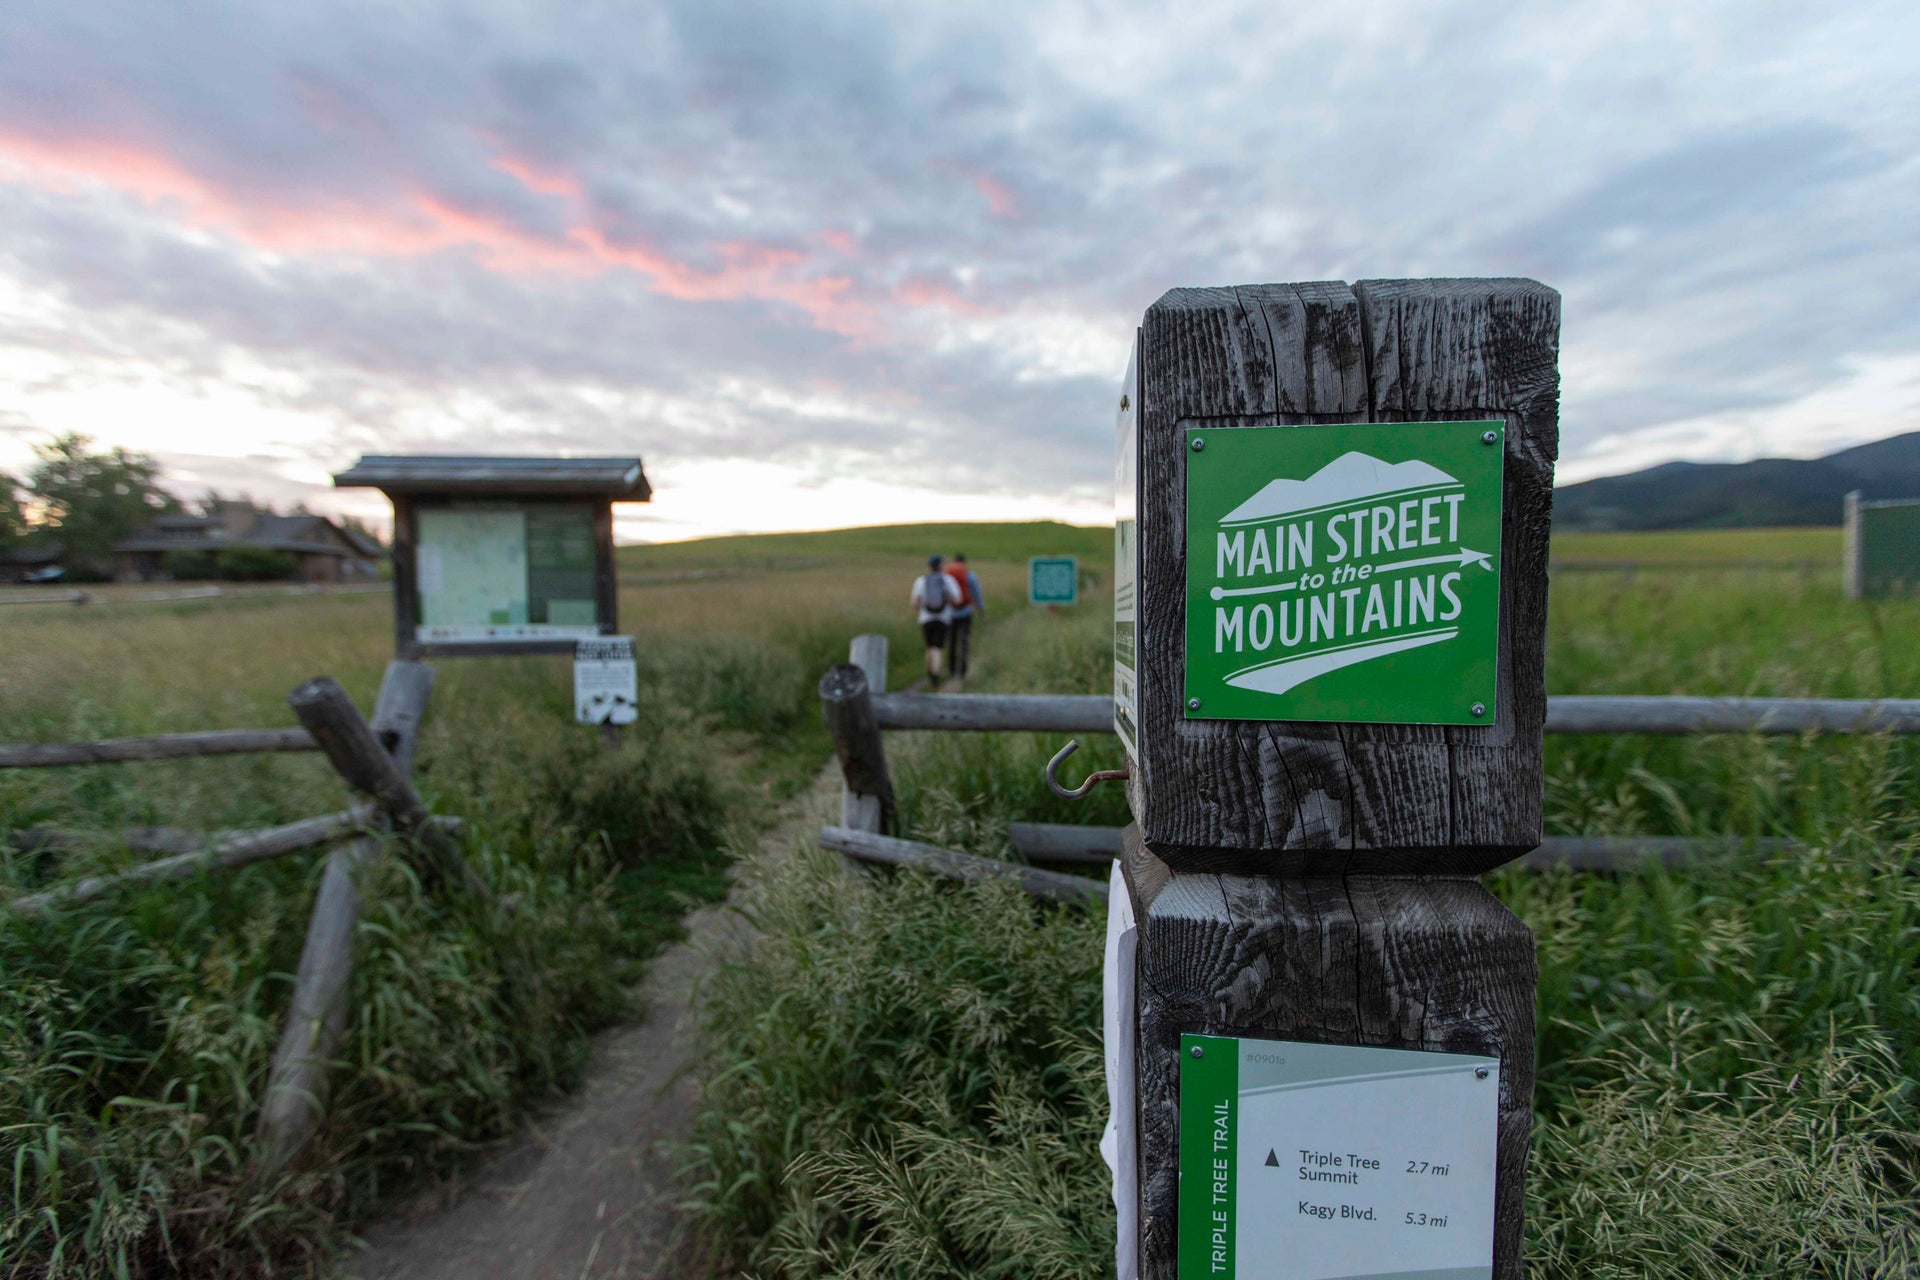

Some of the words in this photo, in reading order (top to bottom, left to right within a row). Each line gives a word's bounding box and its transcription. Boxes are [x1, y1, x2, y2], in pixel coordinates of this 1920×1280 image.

[1216, 520, 1314, 578] MAIN
[1326, 493, 1465, 563] STREET
[1299, 572, 1325, 591] to
[1331, 564, 1373, 586] the
[1215, 572, 1462, 653] MOUNTAINS
[1213, 1099, 1229, 1152] TRAIL
[1299, 1150, 1342, 1168] Triple
[1347, 1154, 1380, 1170] Tree
[1406, 1160, 1429, 1174] 2.7
[1431, 1163, 1450, 1176] mi
[1213, 1158, 1228, 1205] TREE
[1299, 1167, 1358, 1185] Summit
[1299, 1200, 1336, 1220] Kagy
[1341, 1204, 1377, 1221] Blvd.
[1405, 1212, 1427, 1226] 5.3
[1430, 1215, 1448, 1228] mi
[1212, 1211, 1228, 1273] TRIPLE
